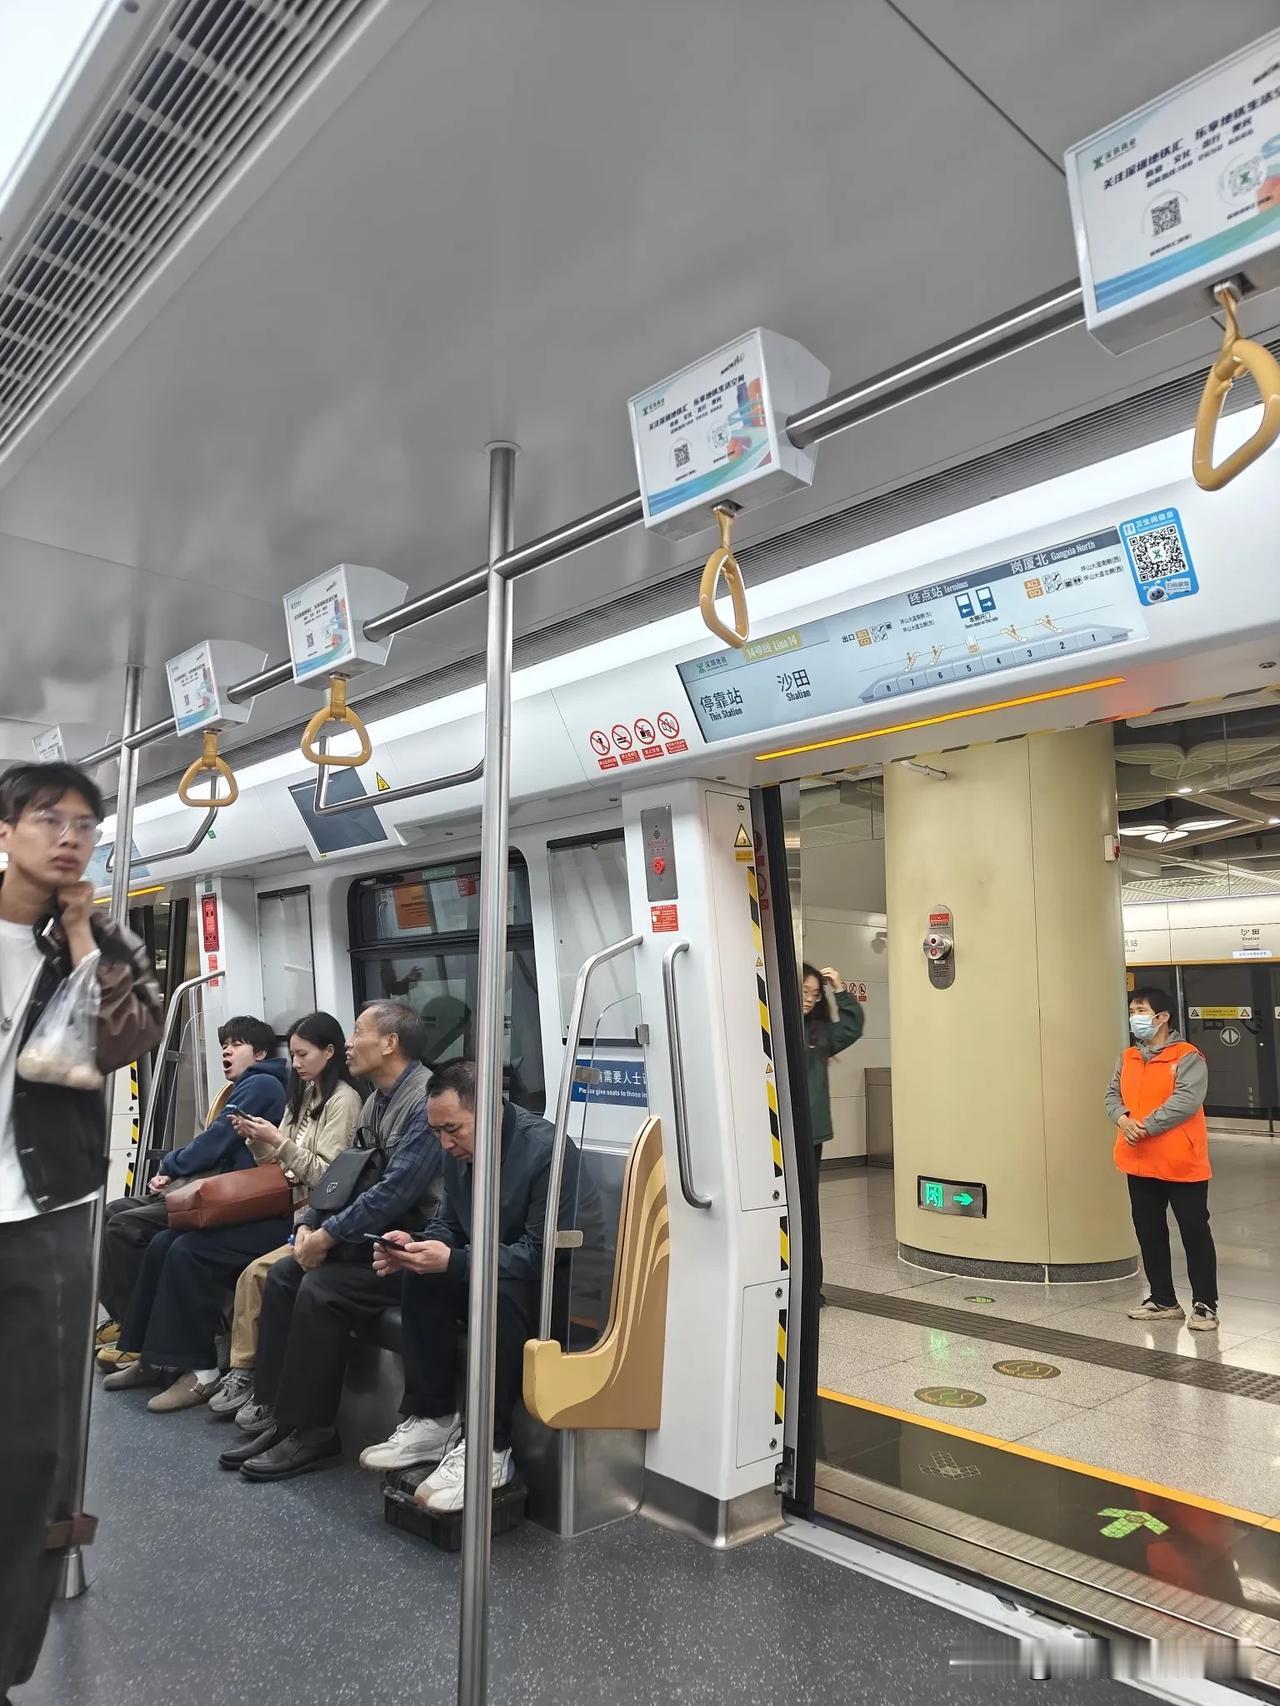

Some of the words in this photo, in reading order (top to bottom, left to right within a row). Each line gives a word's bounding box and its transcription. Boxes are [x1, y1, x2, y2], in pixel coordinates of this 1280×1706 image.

[1010, 552, 1049, 575] 岗厦北
[1050, 547, 1076, 562] Gangxia
[1076, 540, 1096, 554] North
[909, 586, 944, 605] 终点站
[841, 633, 855, 643] 出口
[776, 668, 811, 693] 沙田
[700, 687, 743, 714] 停靠站
[785, 689, 812, 702] Shatian
[709, 710, 722, 723] This
[722, 706, 743, 720] Station
[1240, 928, 1260, 937] 沙田
[607, 1089, 620, 1097] seats
